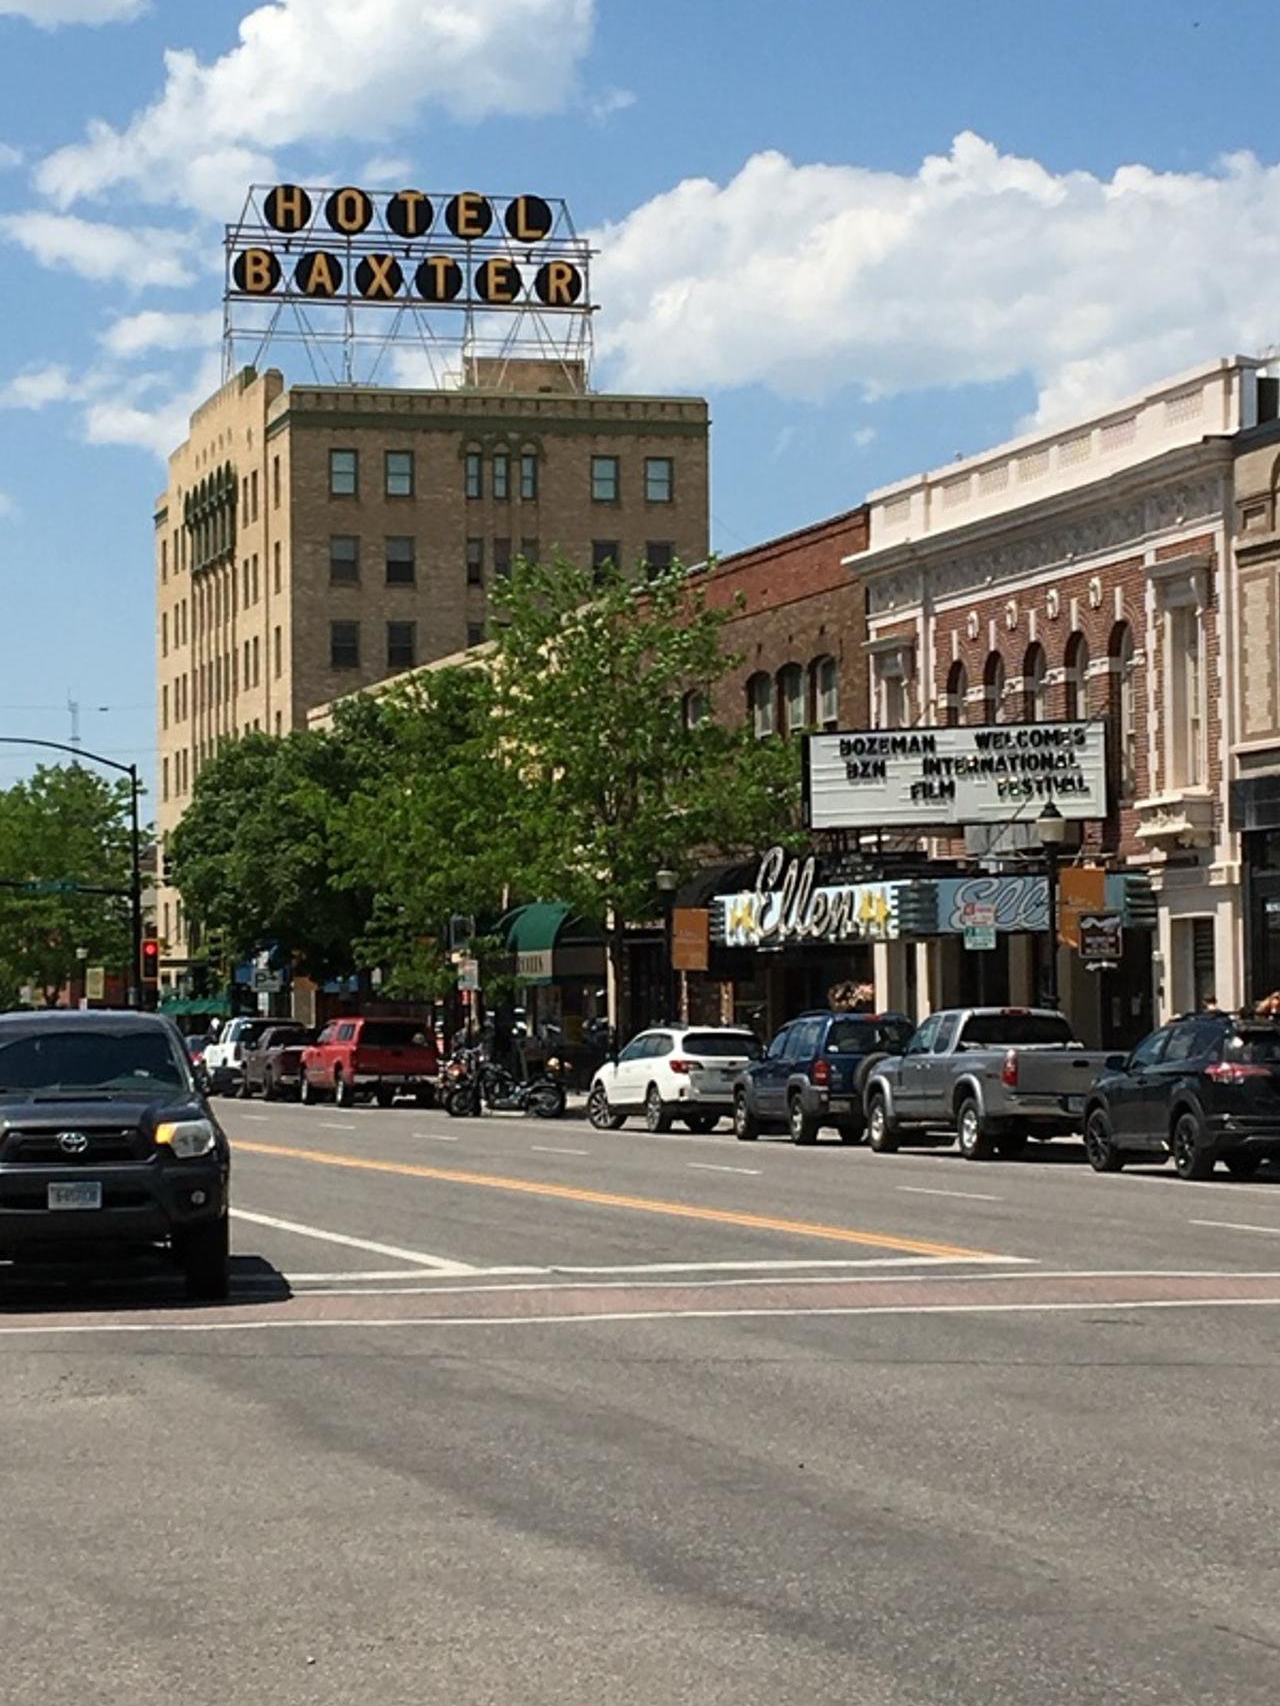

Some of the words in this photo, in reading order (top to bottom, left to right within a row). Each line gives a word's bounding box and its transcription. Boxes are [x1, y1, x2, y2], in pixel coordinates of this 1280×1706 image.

[275, 185, 544, 240] HOTEL
[245, 248, 573, 303] BAXTER
[839, 733, 936, 756] BOZEMAN
[974, 727, 1087, 749] WELCOMES
[846, 759, 886, 780] BZN
[922, 751, 1080, 776] INTERNATIONAL
[910, 780, 956, 800] FILM
[996, 774, 1090, 797] FESTIVAL
[752, 846, 862, 938] Ellen
